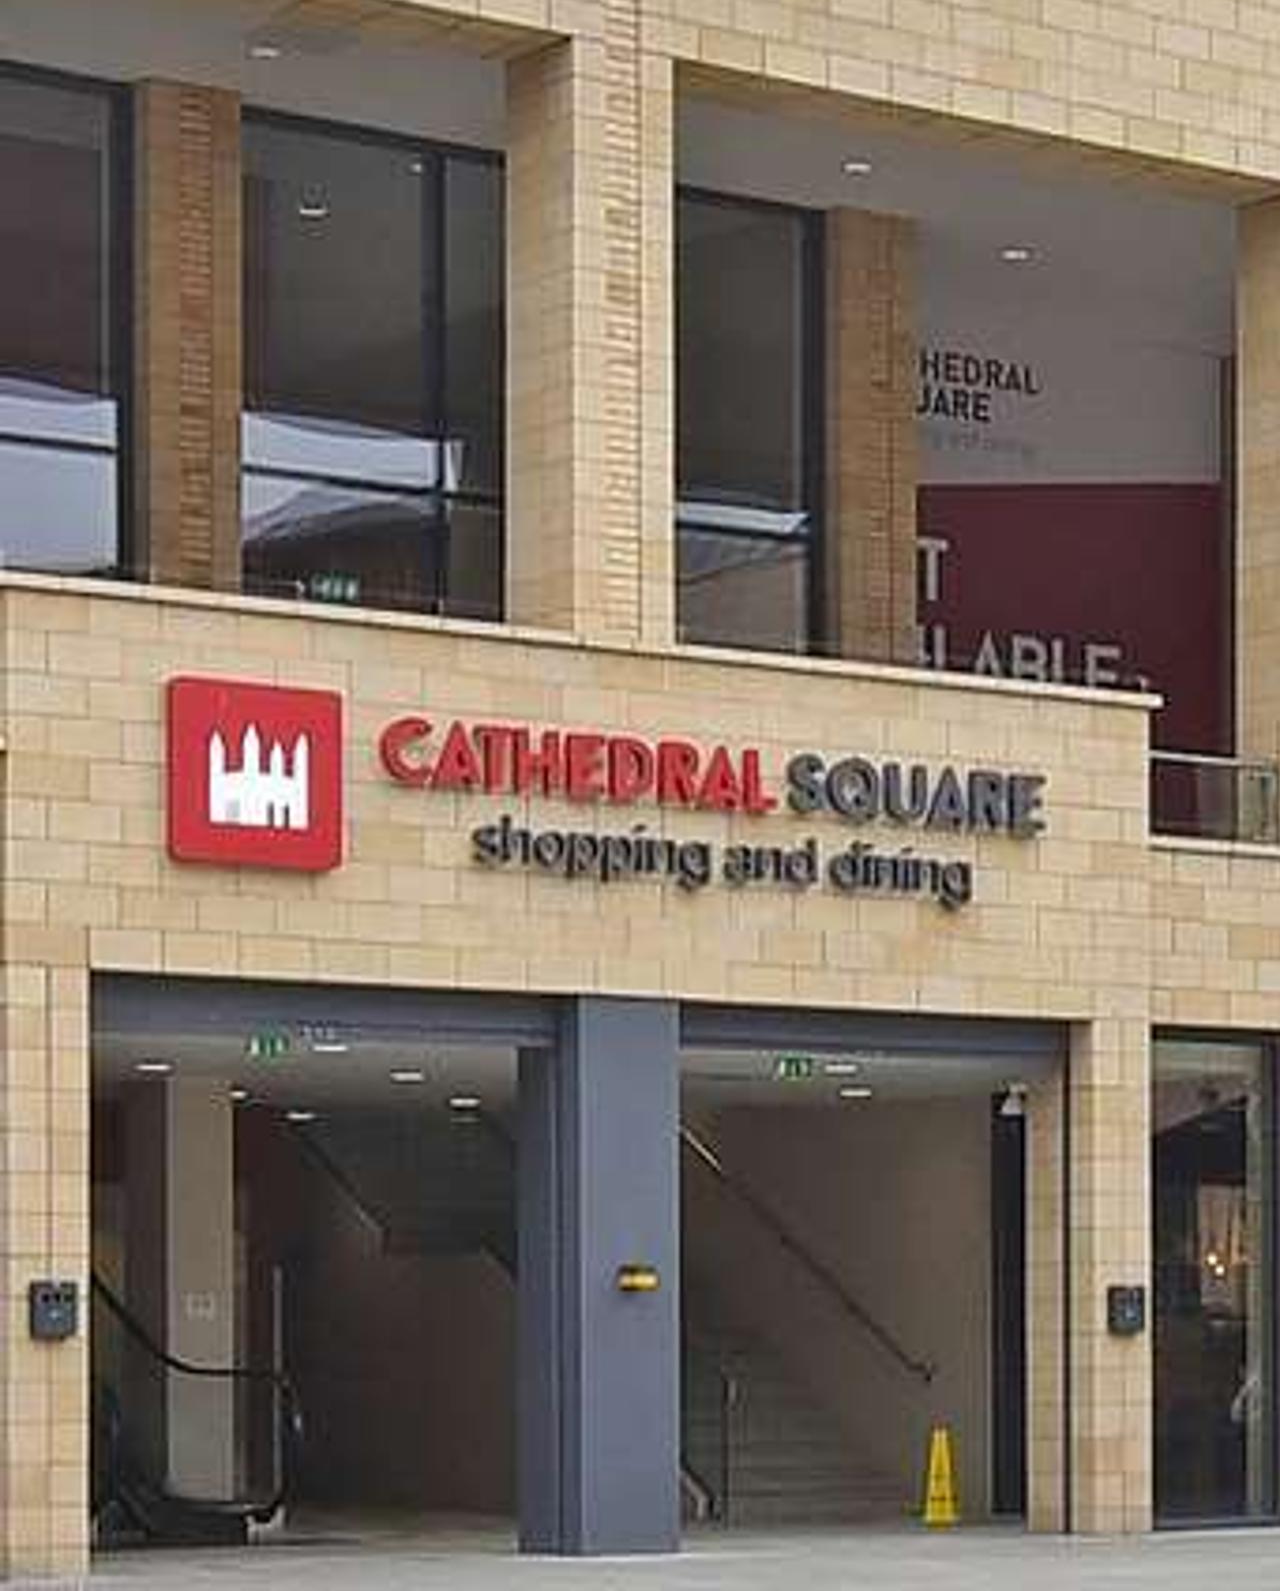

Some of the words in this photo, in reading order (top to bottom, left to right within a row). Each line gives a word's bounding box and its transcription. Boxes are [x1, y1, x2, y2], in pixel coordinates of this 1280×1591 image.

[378, 717, 777, 813] CATHEDRAL
[786, 752, 1047, 836] SQUARE
[470, 814, 711, 891] shopping
[723, 837, 818, 886] and
[829, 838, 973, 907] dining
